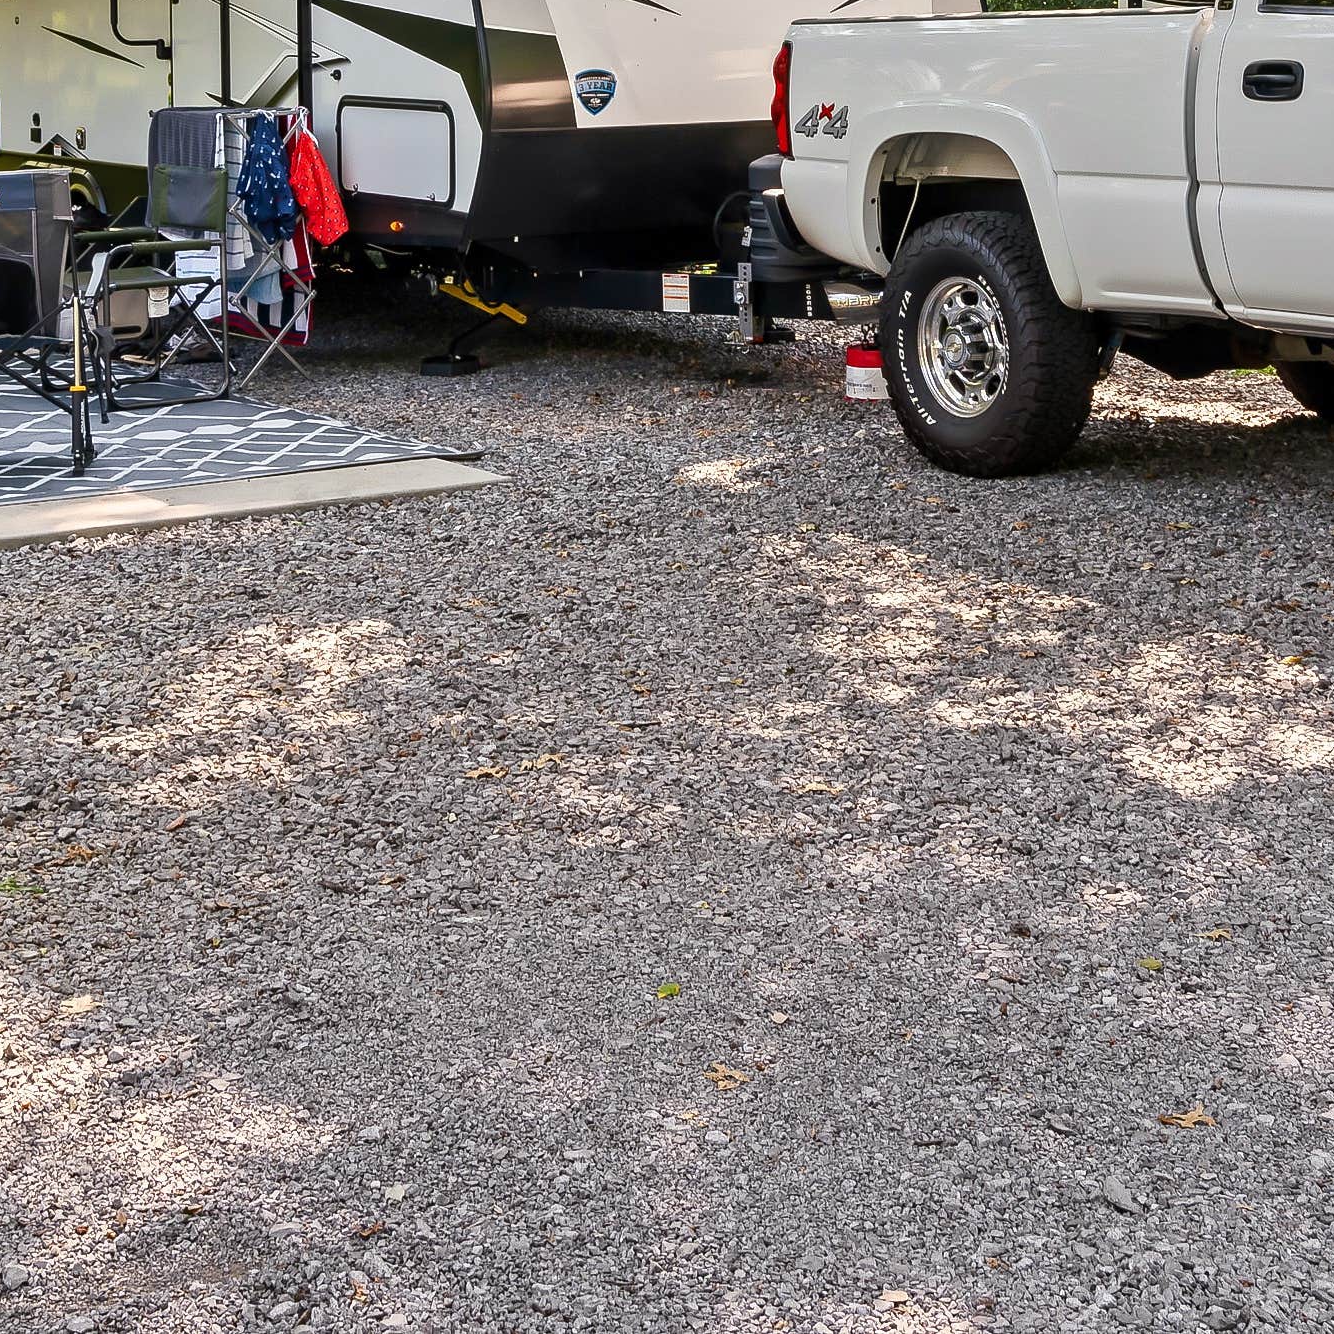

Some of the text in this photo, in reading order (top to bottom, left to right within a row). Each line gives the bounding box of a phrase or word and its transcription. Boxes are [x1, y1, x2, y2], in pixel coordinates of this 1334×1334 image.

[577, 81, 613, 92] 3 YEAR
[896, 290, 937, 426] All-Terrain T/A
